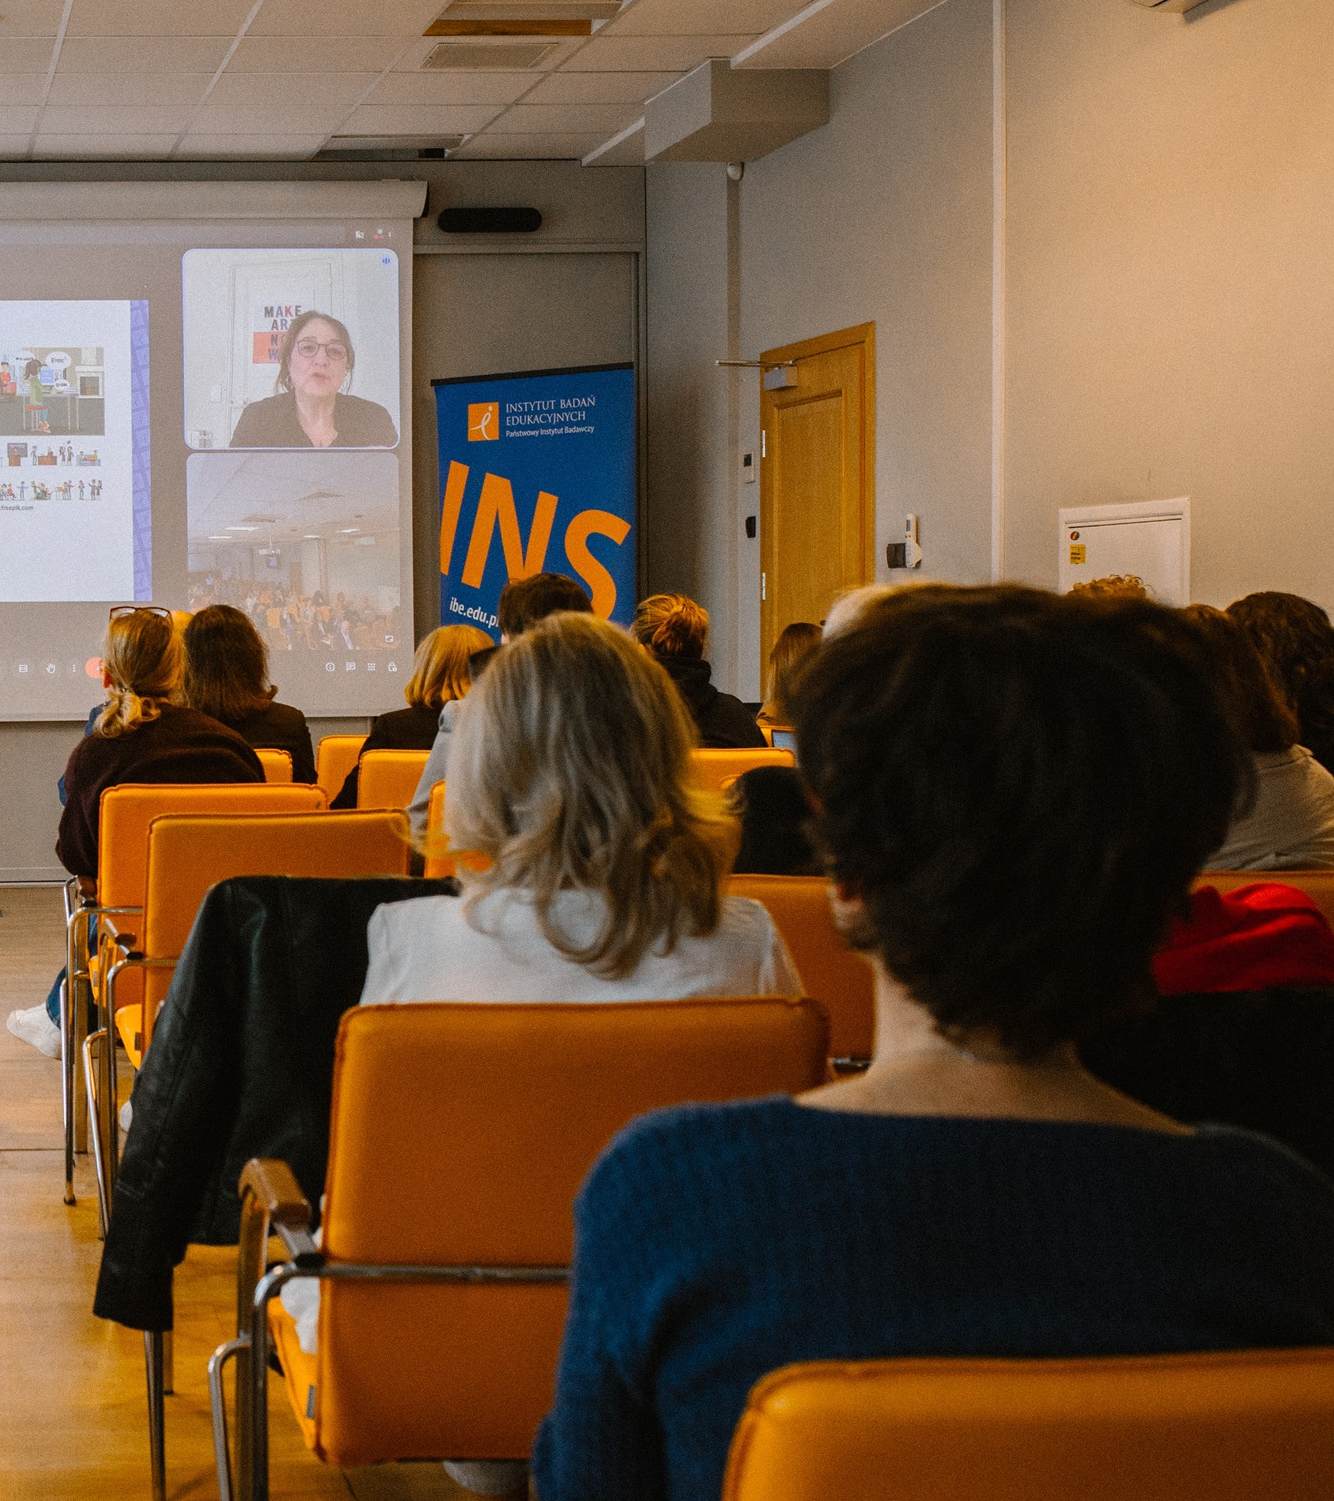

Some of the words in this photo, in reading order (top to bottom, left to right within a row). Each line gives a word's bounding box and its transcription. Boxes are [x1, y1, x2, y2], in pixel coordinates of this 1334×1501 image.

[264, 304, 302, 318] MAKE
[271, 318, 293, 331] AR
[506, 399, 556, 413] INSTYTUT
[559, 395, 596, 409] BADAŃ
[506, 410, 586, 426] EDUKACYJNYCH
[505, 429, 539, 437] Państwowy
[539, 427, 564, 436] Instytut
[564, 425, 595, 434] Badawczy
[440, 460, 632, 622] INS
